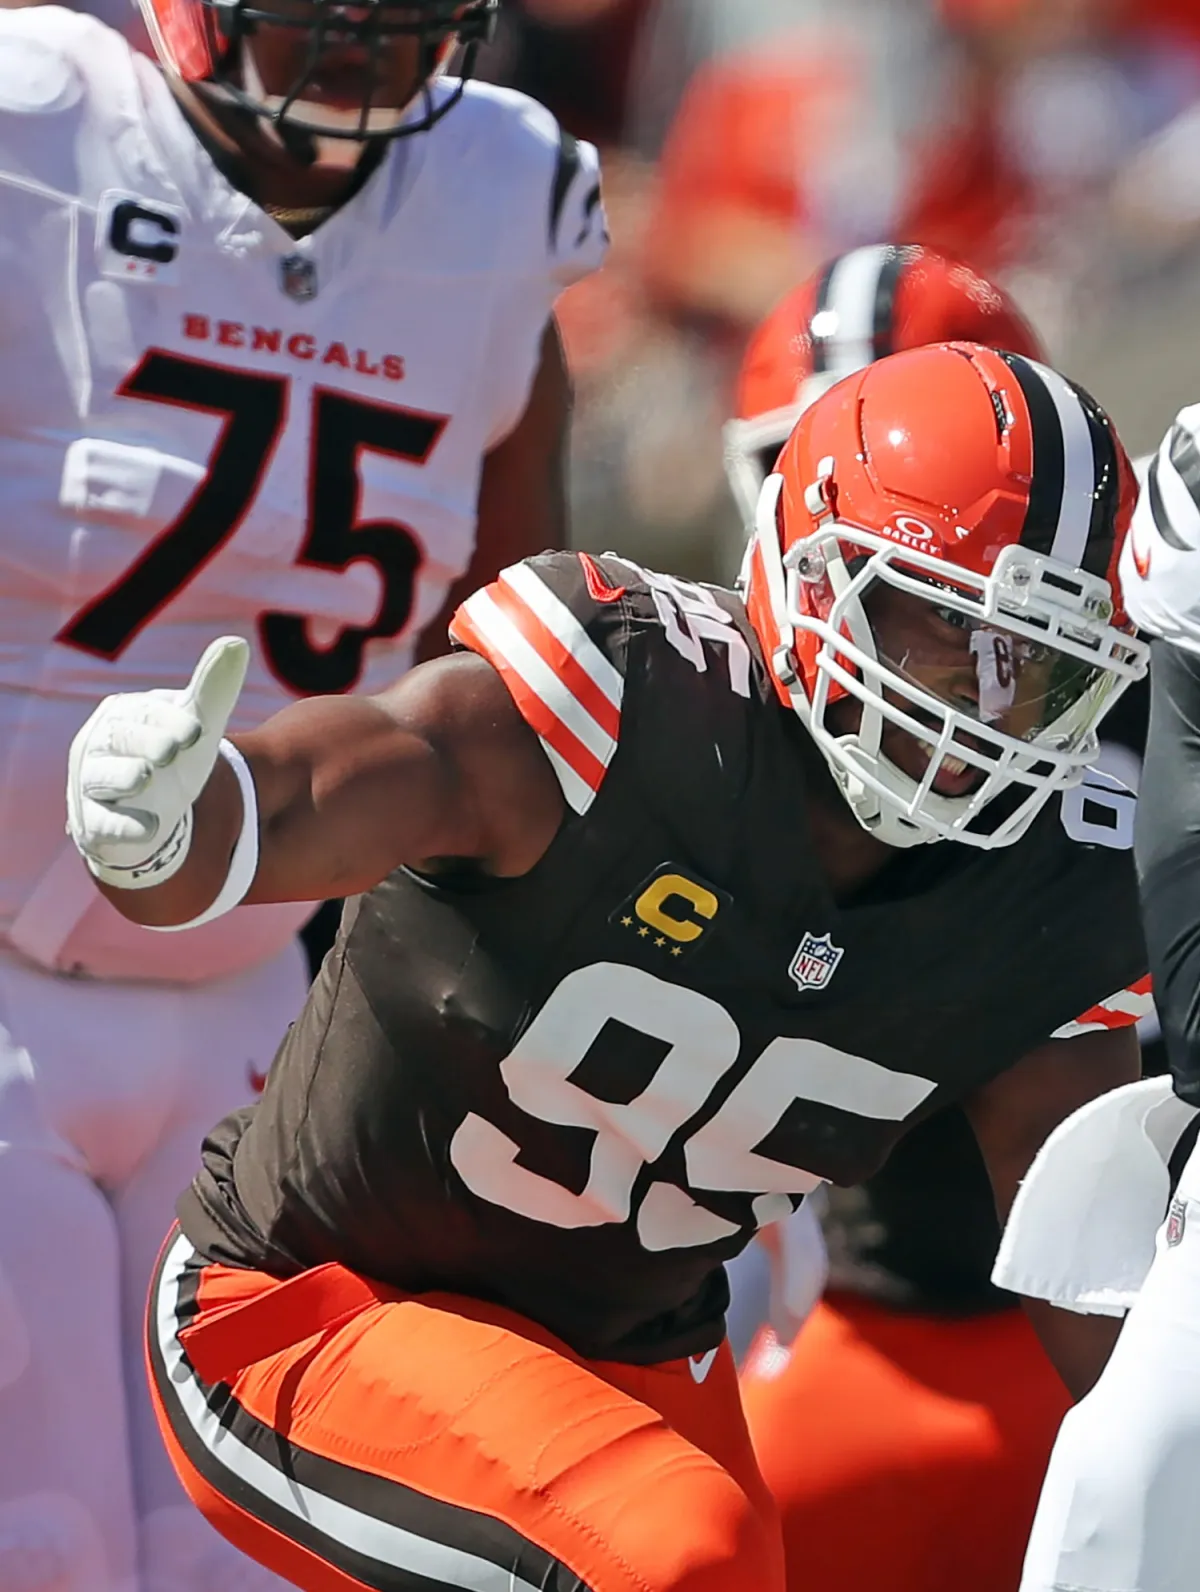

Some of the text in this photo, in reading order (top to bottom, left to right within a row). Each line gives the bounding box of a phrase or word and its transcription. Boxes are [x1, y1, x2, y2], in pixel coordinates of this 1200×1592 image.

[110, 199, 181, 264] C
[183, 313, 406, 381] BENGALS
[54, 346, 452, 698] 75
[882, 526, 941, 554] OAKLEY
[635, 873, 719, 942] C
[450, 961, 938, 1251] 95
